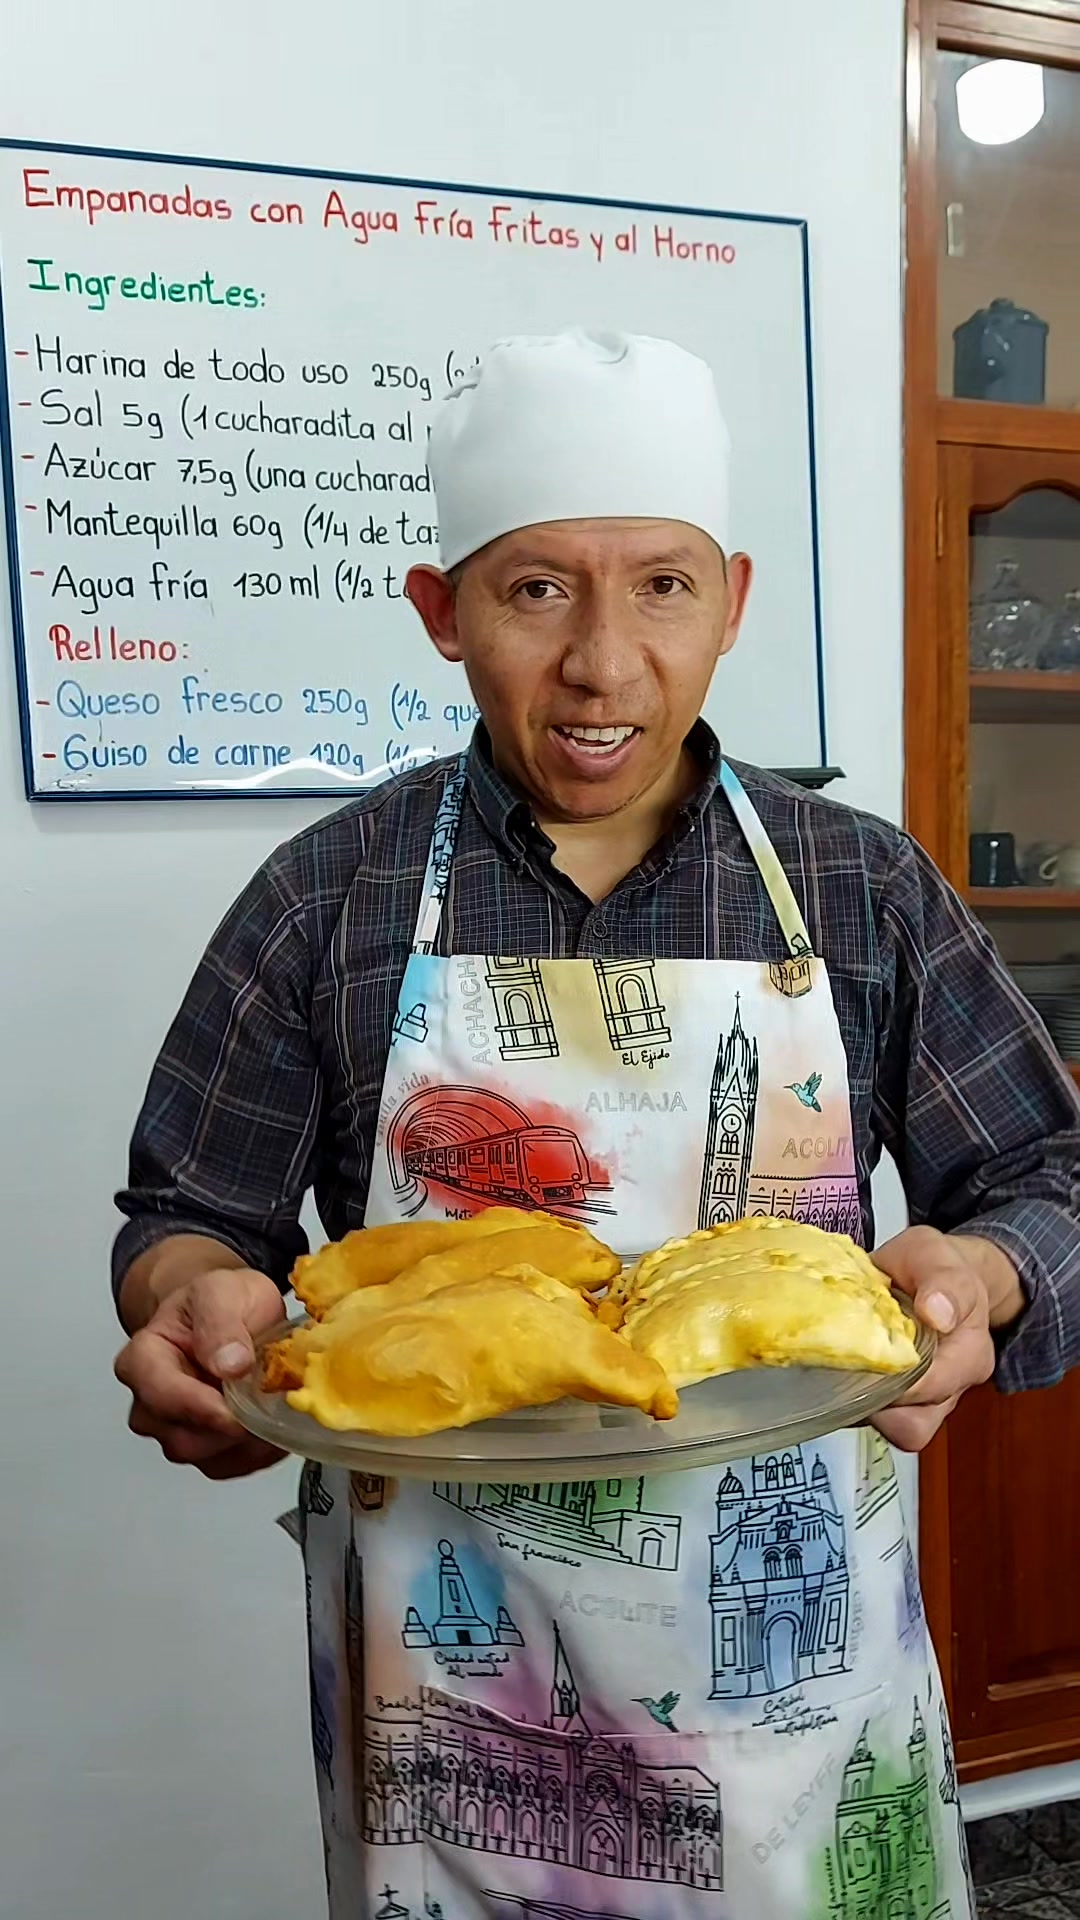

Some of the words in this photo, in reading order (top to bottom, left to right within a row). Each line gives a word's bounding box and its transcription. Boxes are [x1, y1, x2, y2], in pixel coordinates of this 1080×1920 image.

[21, 166, 234, 227] Empanadas
[248, 200, 304, 226] con
[322, 188, 399, 246] Agua
[589, 230, 604, 263] y
[614, 224, 638, 255] al
[654, 224, 737, 266] Horno
[25, 256, 267, 312] Ingredientes:
[162, 347, 197, 382] de
[207, 346, 286, 386] todo
[300, 362, 349, 386] uso
[370, 362, 433, 402] 250g
[121, 402, 164, 440] 5g
[387, 410, 413, 443] al
[244, 447, 307, 493] (una
[314, 458, 438, 493] cucharad
[231, 513, 284, 550] 60g
[358, 514, 391, 545] de
[148, 560, 209, 602] fría
[232, 571, 283, 598] 130
[288, 563, 321, 600] ml
[47, 622, 190, 662] Relleno:
[181, 674, 284, 715] fresco
[301, 687, 370, 727] 250g
[166, 734, 201, 766] de
[214, 747, 292, 768] carne
[308, 740, 365, 777] 120g
[456, 956, 495, 1067] ACHACH
[621, 1049, 640, 1066] El
[640, 1047, 671, 1070] Ejido
[584, 1090, 689, 1113] ALHAJA
